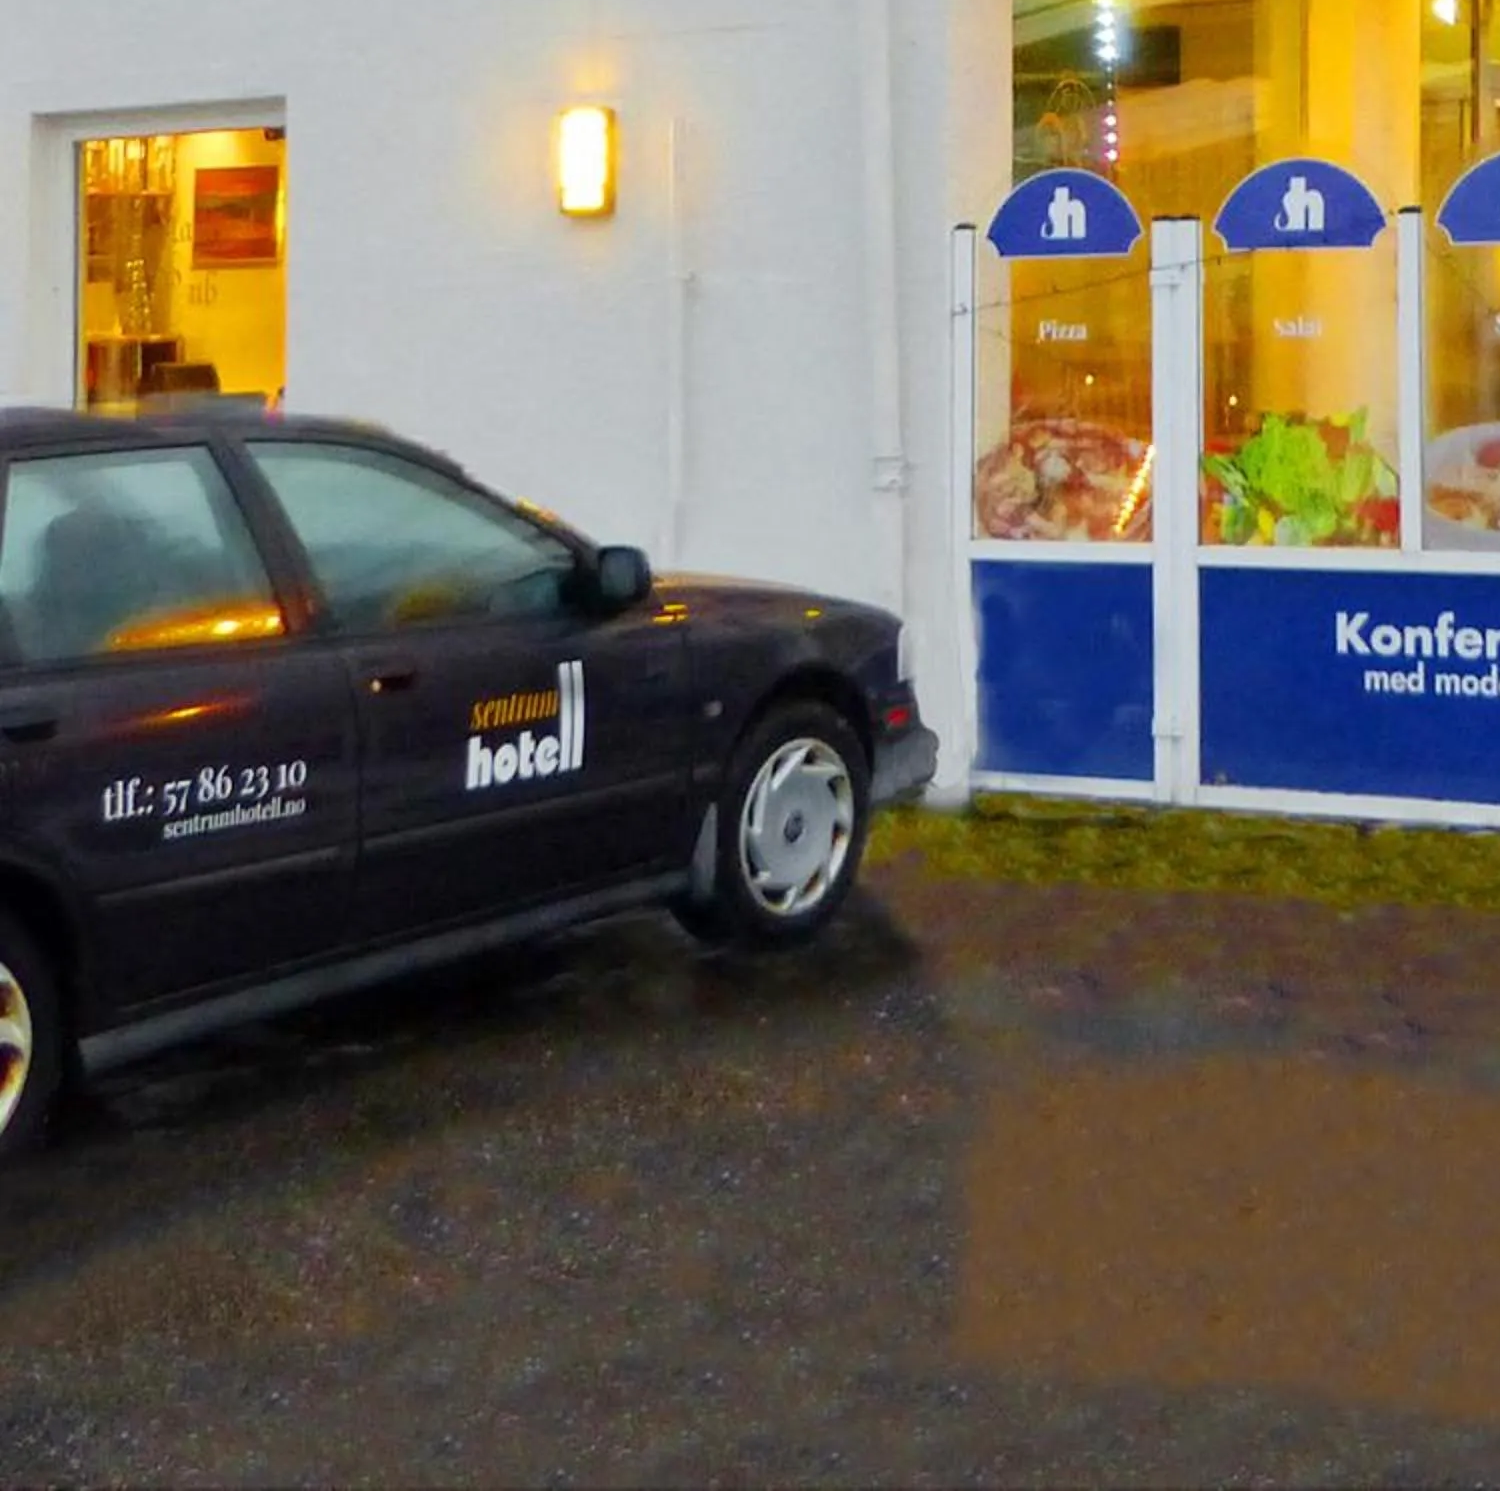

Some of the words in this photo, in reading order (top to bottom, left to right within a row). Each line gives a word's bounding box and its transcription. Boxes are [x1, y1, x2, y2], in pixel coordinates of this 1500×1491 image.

[1038, 319, 1088, 341] Pizza
[1363, 660, 1426, 695] med
[465, 659, 585, 791] hotell
[163, 779, 193, 817] 57
[197, 763, 233, 803] 86
[239, 764, 270, 799] 23
[276, 759, 307, 792] 10
[163, 796, 306, 840] sentrumhotell.no
